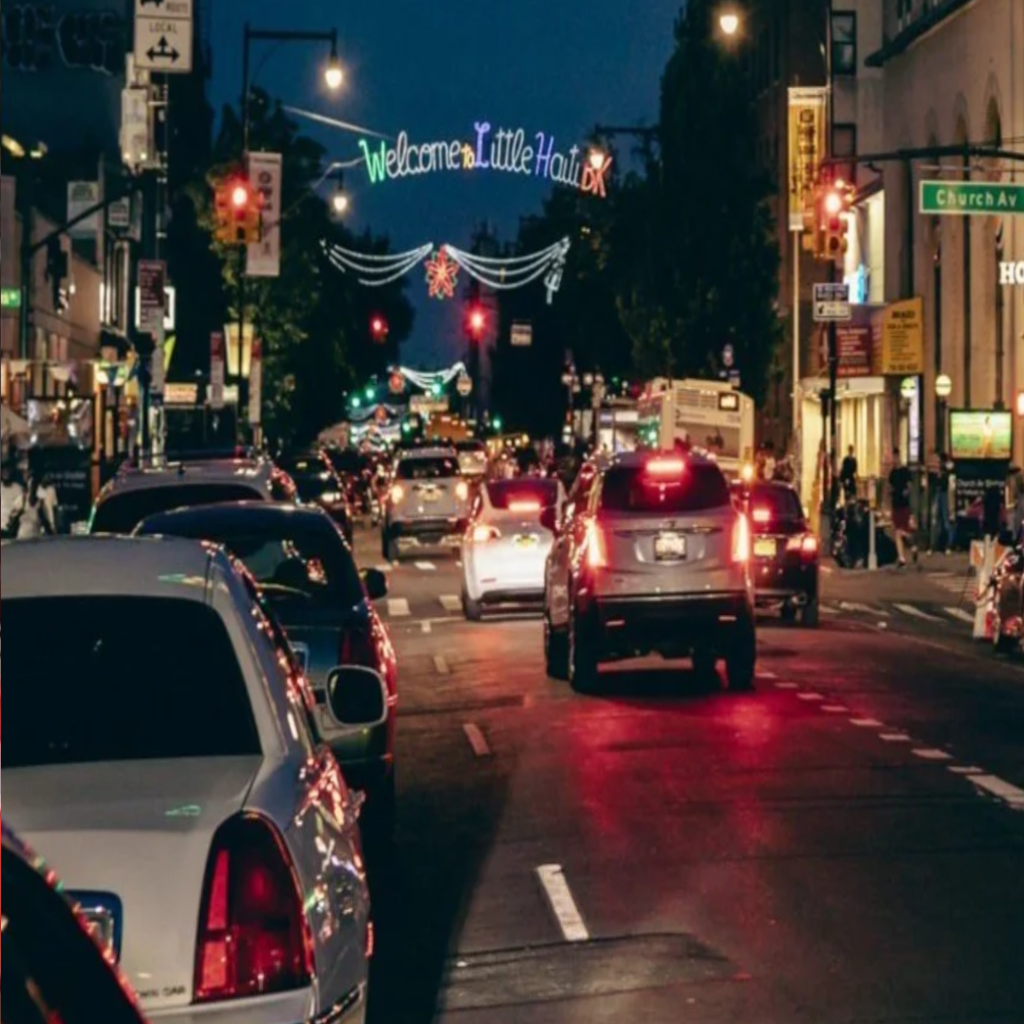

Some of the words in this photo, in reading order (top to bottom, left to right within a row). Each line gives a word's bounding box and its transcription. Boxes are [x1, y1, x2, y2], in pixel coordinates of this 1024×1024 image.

[148, 21, 178, 34] LOCAL
[358, 130, 461, 184] Welcome
[473, 121, 535, 174] Little
[534, 131, 581, 187] Haiti
[935, 187, 995, 208] Church
[997, 189, 1018, 209] Av
